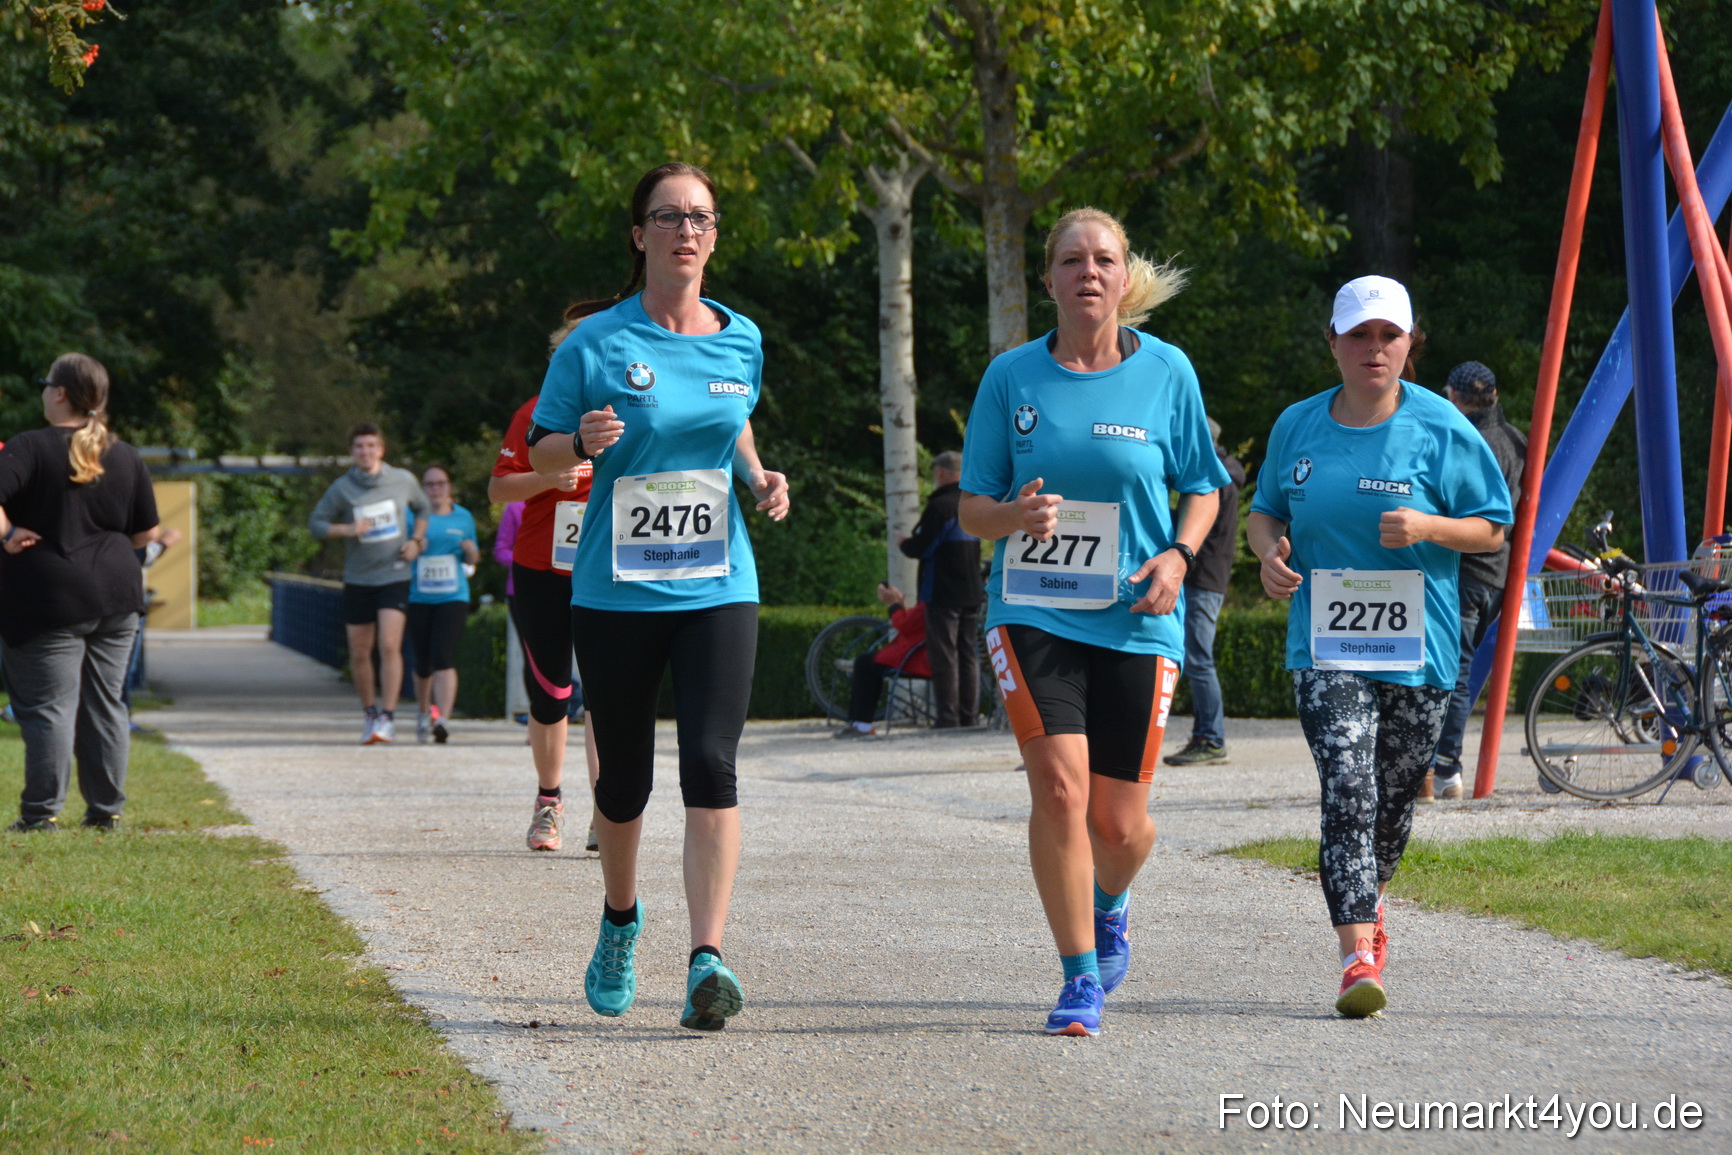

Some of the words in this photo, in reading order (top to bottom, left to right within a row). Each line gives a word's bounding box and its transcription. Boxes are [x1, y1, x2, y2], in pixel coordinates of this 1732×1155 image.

[708, 381, 750, 397] BOCK
[627, 394, 658, 402] PARTL
[1091, 422, 1148, 442] BOCK
[658, 480, 697, 491] BOCK
[1358, 477, 1413, 496] BOCK
[631, 503, 712, 538] 2476
[1057, 510, 1086, 520] OCK
[643, 548, 700, 563] Stephanie
[1020, 532, 1101, 567] 2277
[1040, 576, 1078, 590] Sabine
[1354, 579, 1392, 588] BOCK
[1328, 601, 1408, 631] 2278
[1340, 642, 1396, 655] Stephanie
